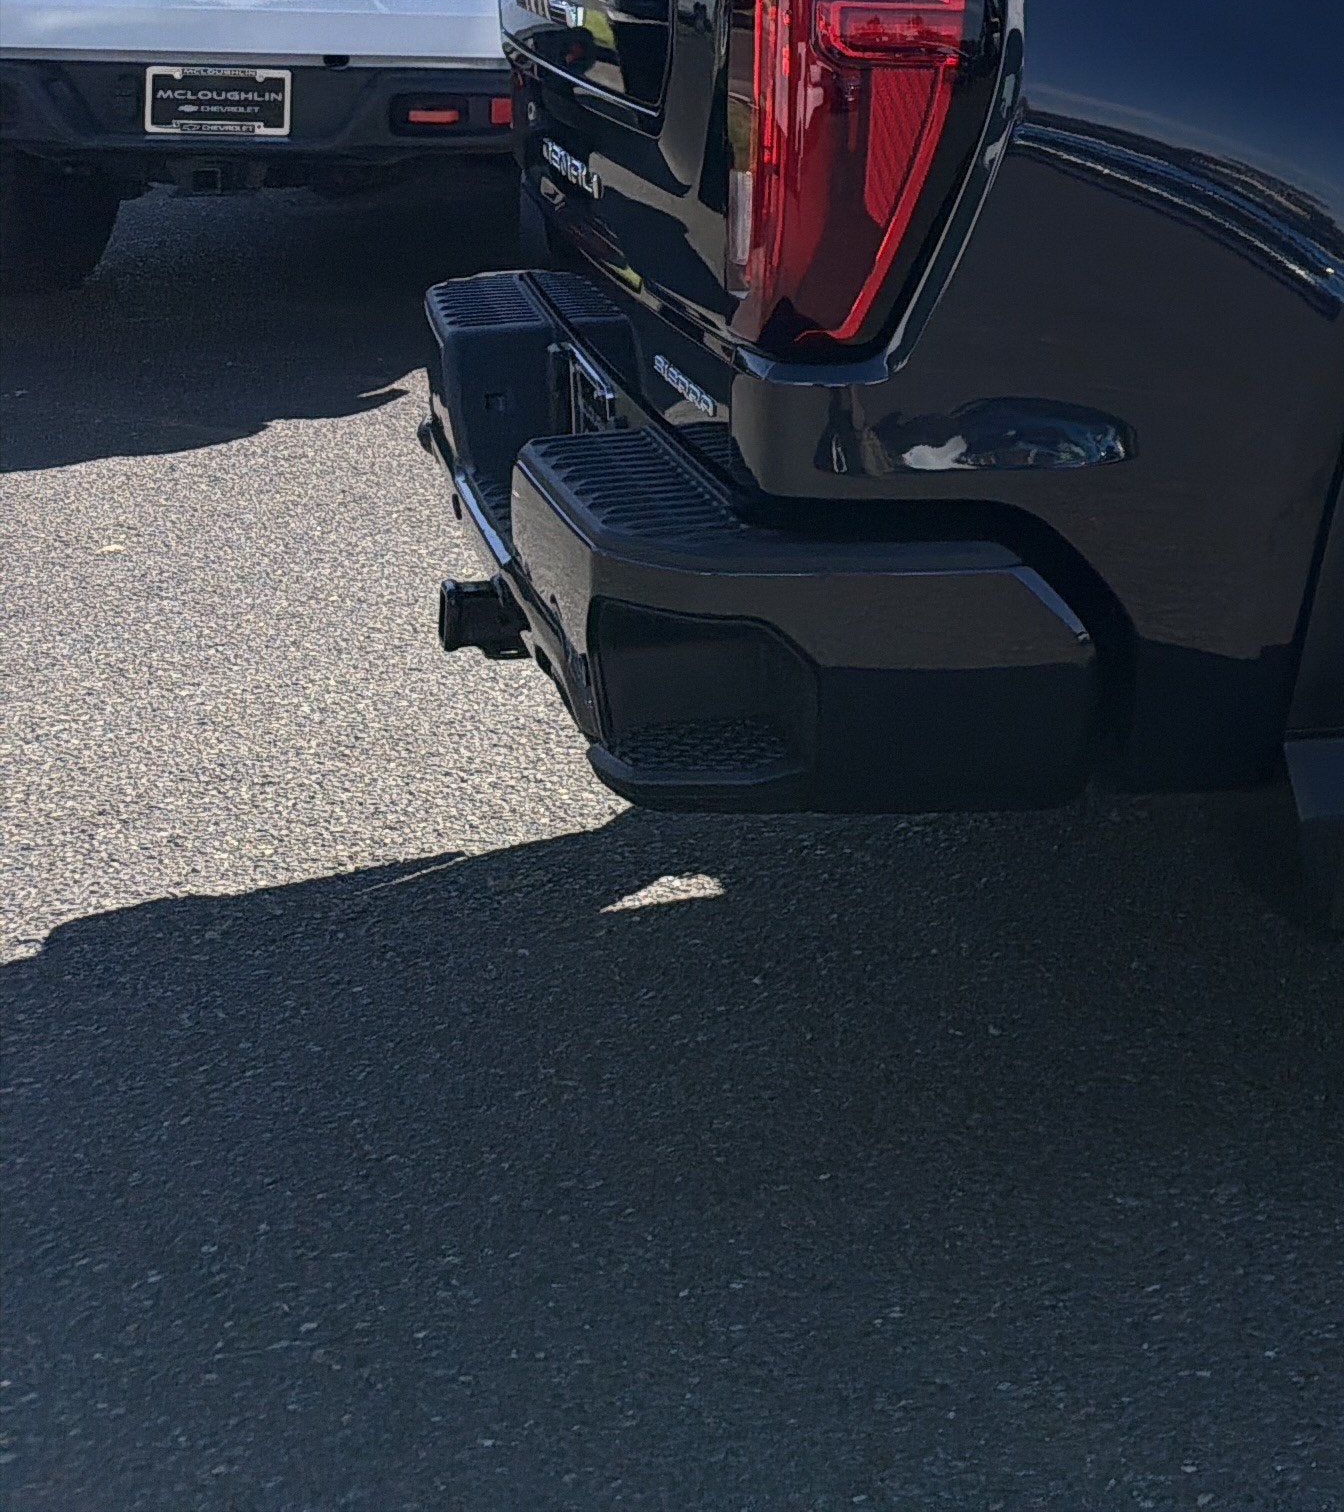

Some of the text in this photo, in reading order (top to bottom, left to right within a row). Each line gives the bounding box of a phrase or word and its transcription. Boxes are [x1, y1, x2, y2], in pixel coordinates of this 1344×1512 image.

[156, 89, 283, 102] MCLOUGHLIN
[200, 105, 261, 114] CHEVROLET
[542, 136, 603, 200] DENALI
[654, 354, 717, 417] SIERRA
